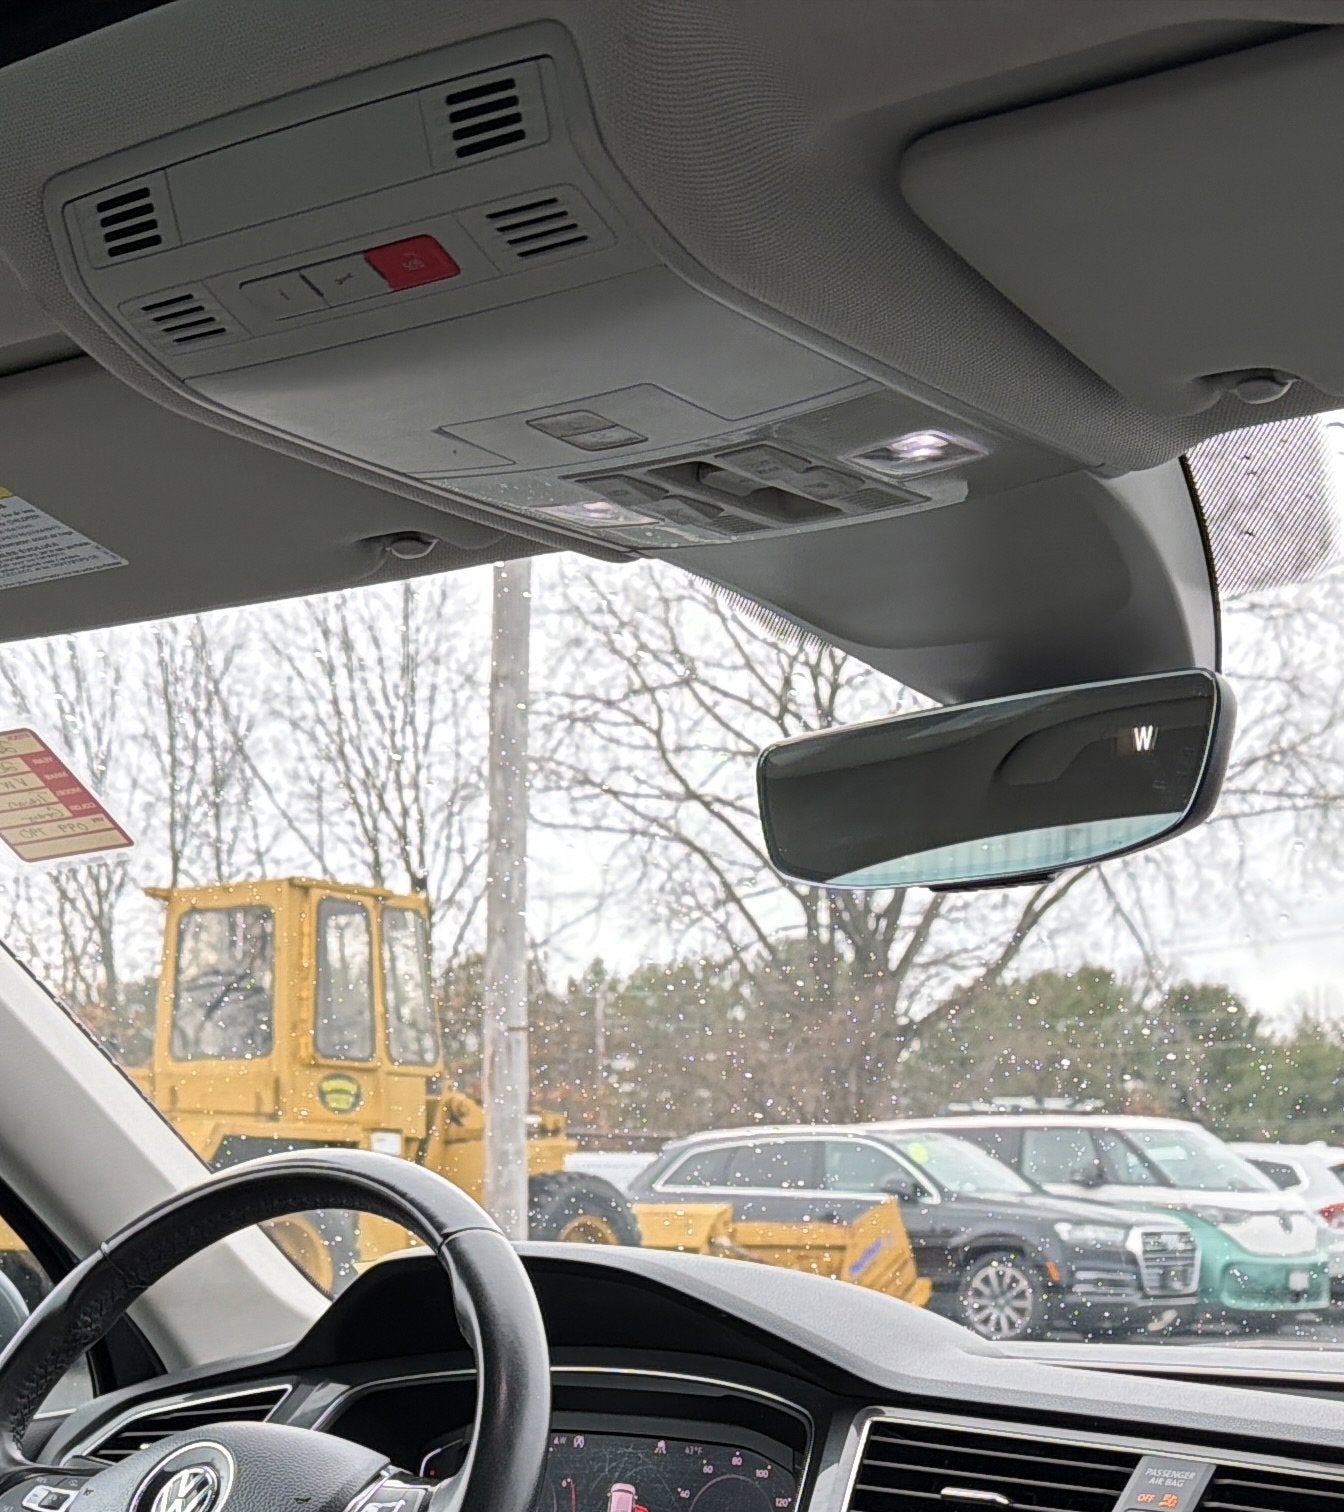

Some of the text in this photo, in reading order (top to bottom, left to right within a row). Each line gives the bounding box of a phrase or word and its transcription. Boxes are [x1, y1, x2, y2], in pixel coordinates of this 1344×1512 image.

[1132, 725, 1153, 751] W
[1145, 1468, 1196, 1481] PASSENGER
[1148, 1476, 1184, 1488] AIR BAG
[1137, 1493, 1156, 1503] OFF
